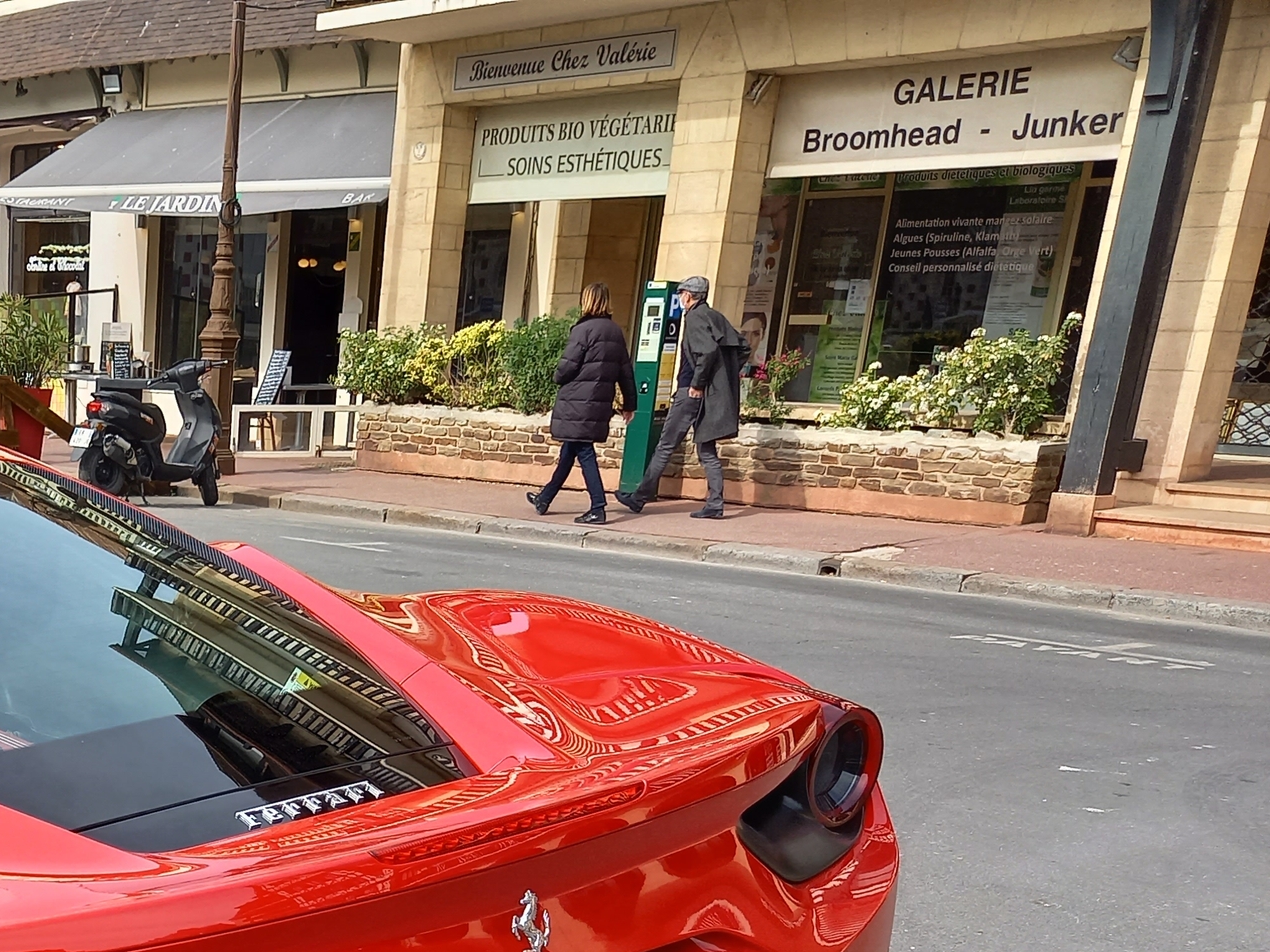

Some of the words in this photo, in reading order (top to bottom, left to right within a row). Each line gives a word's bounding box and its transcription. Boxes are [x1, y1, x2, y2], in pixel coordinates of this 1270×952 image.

[469, 60, 545, 82] Bienvenue
[551, 49, 589, 71] Chez
[596, 41, 657, 67] Valérie
[893, 66, 1032, 105] GALERIE
[481, 123, 555, 147] PRODUITS
[557, 120, 585, 141] BIO
[802, 118, 962, 154] Broomhead
[1011, 109, 1125, 140] Junker
[507, 155, 553, 177] SOINS
[557, 147, 663, 173] ESTHÉTIQUES
[1013, 163, 1075, 178] biologiques
[121, 196, 146, 211] LE
[146, 194, 222, 213] JARDIN
[341, 192, 375, 204] BAR
[895, 217, 950, 228] Alimentation
[951, 216, 983, 227] vivante
[1021, 214, 1053, 224] solaire
[893, 232, 924, 245] Algues
[925, 231, 973, 244] (Spiruline,
[890, 248, 922, 258] Jeunes
[923, 248, 961, 257] Pousses
[1028, 244, 1054, 257] Vert)
[888, 262, 922, 273] Conseil
[922, 261, 983, 274] personnalisé
[234, 780, 385, 831] Ferrari
